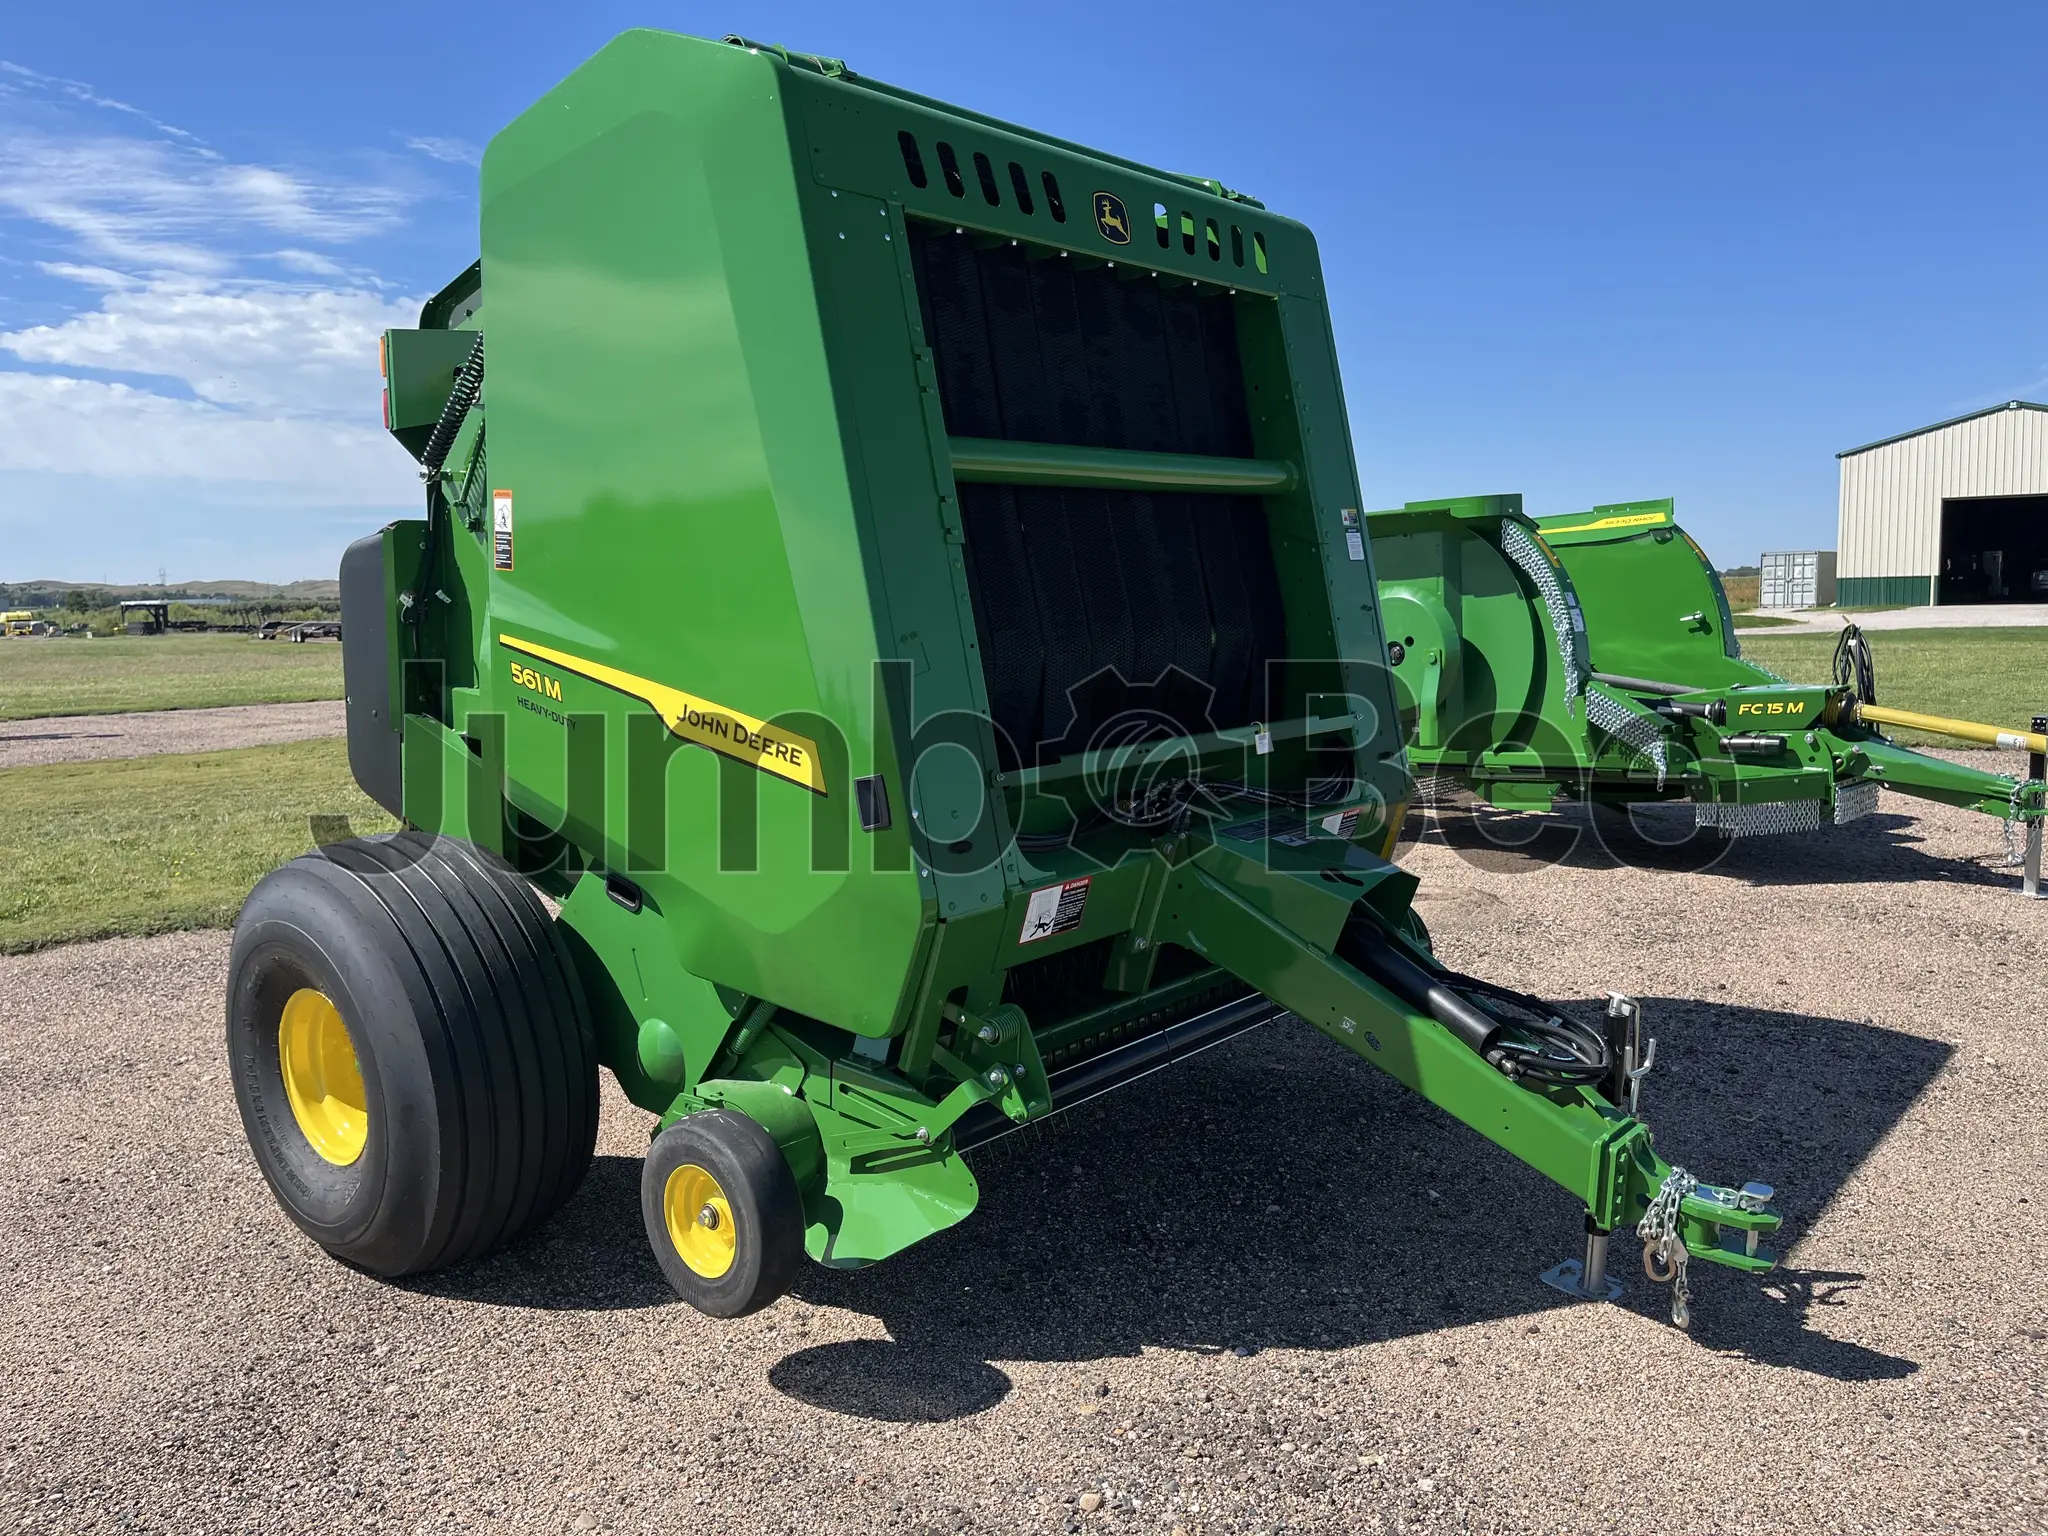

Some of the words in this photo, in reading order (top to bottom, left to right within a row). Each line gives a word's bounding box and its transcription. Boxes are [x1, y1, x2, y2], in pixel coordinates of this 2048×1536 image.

[517, 695, 577, 731] HEAVY-DUTY
[676, 703, 729, 739] JOHN
[732, 714, 804, 767] DEERE
[1070, 879, 1089, 889] DANGER
